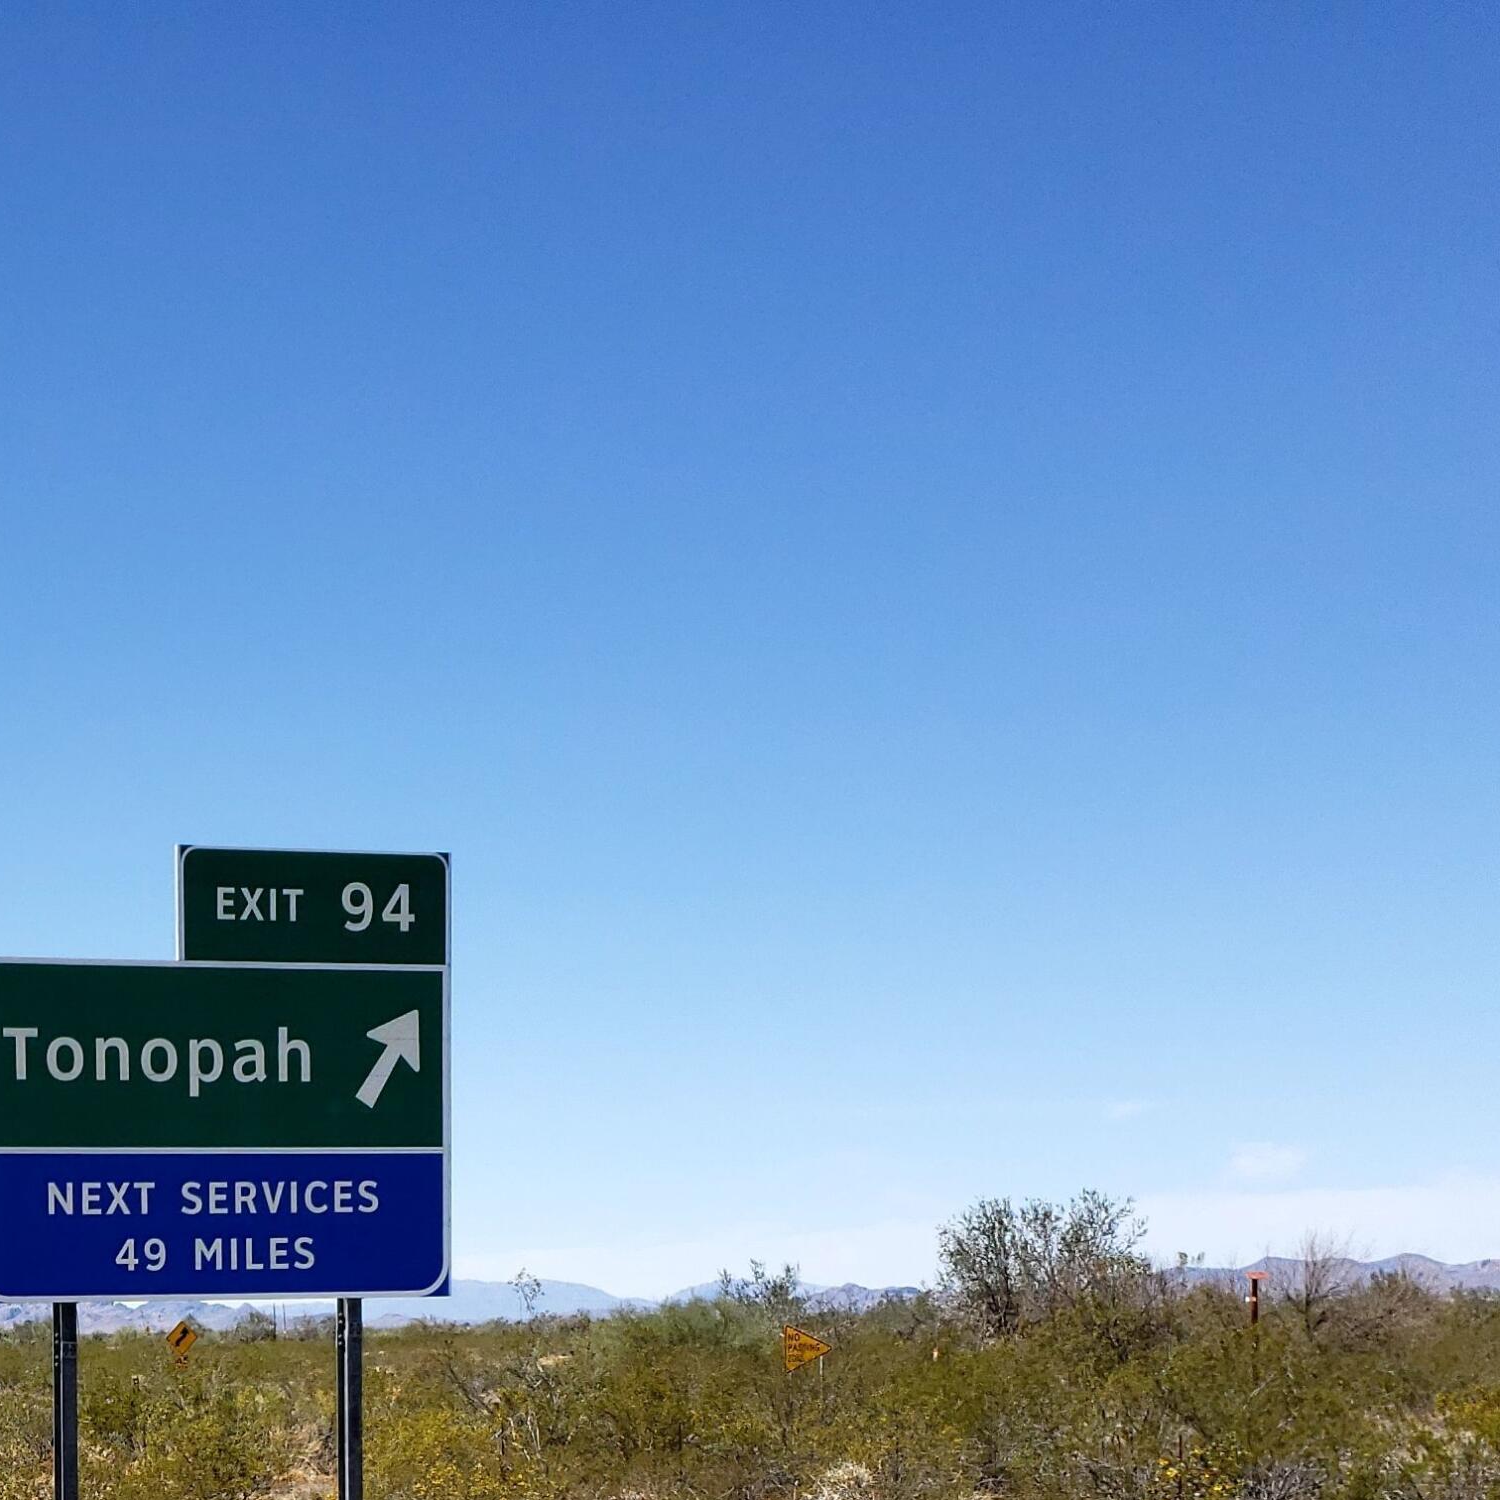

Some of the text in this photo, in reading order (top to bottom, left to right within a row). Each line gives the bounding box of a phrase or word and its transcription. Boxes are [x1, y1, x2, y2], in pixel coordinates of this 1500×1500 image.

[216, 881, 415, 932] EXIT 94
[2, 1026, 311, 1097] Tonopah
[47, 1180, 379, 1215] NEXT SERVICES
[115, 1237, 315, 1272] 49 MILES
[787, 1333, 800, 1342] NO
